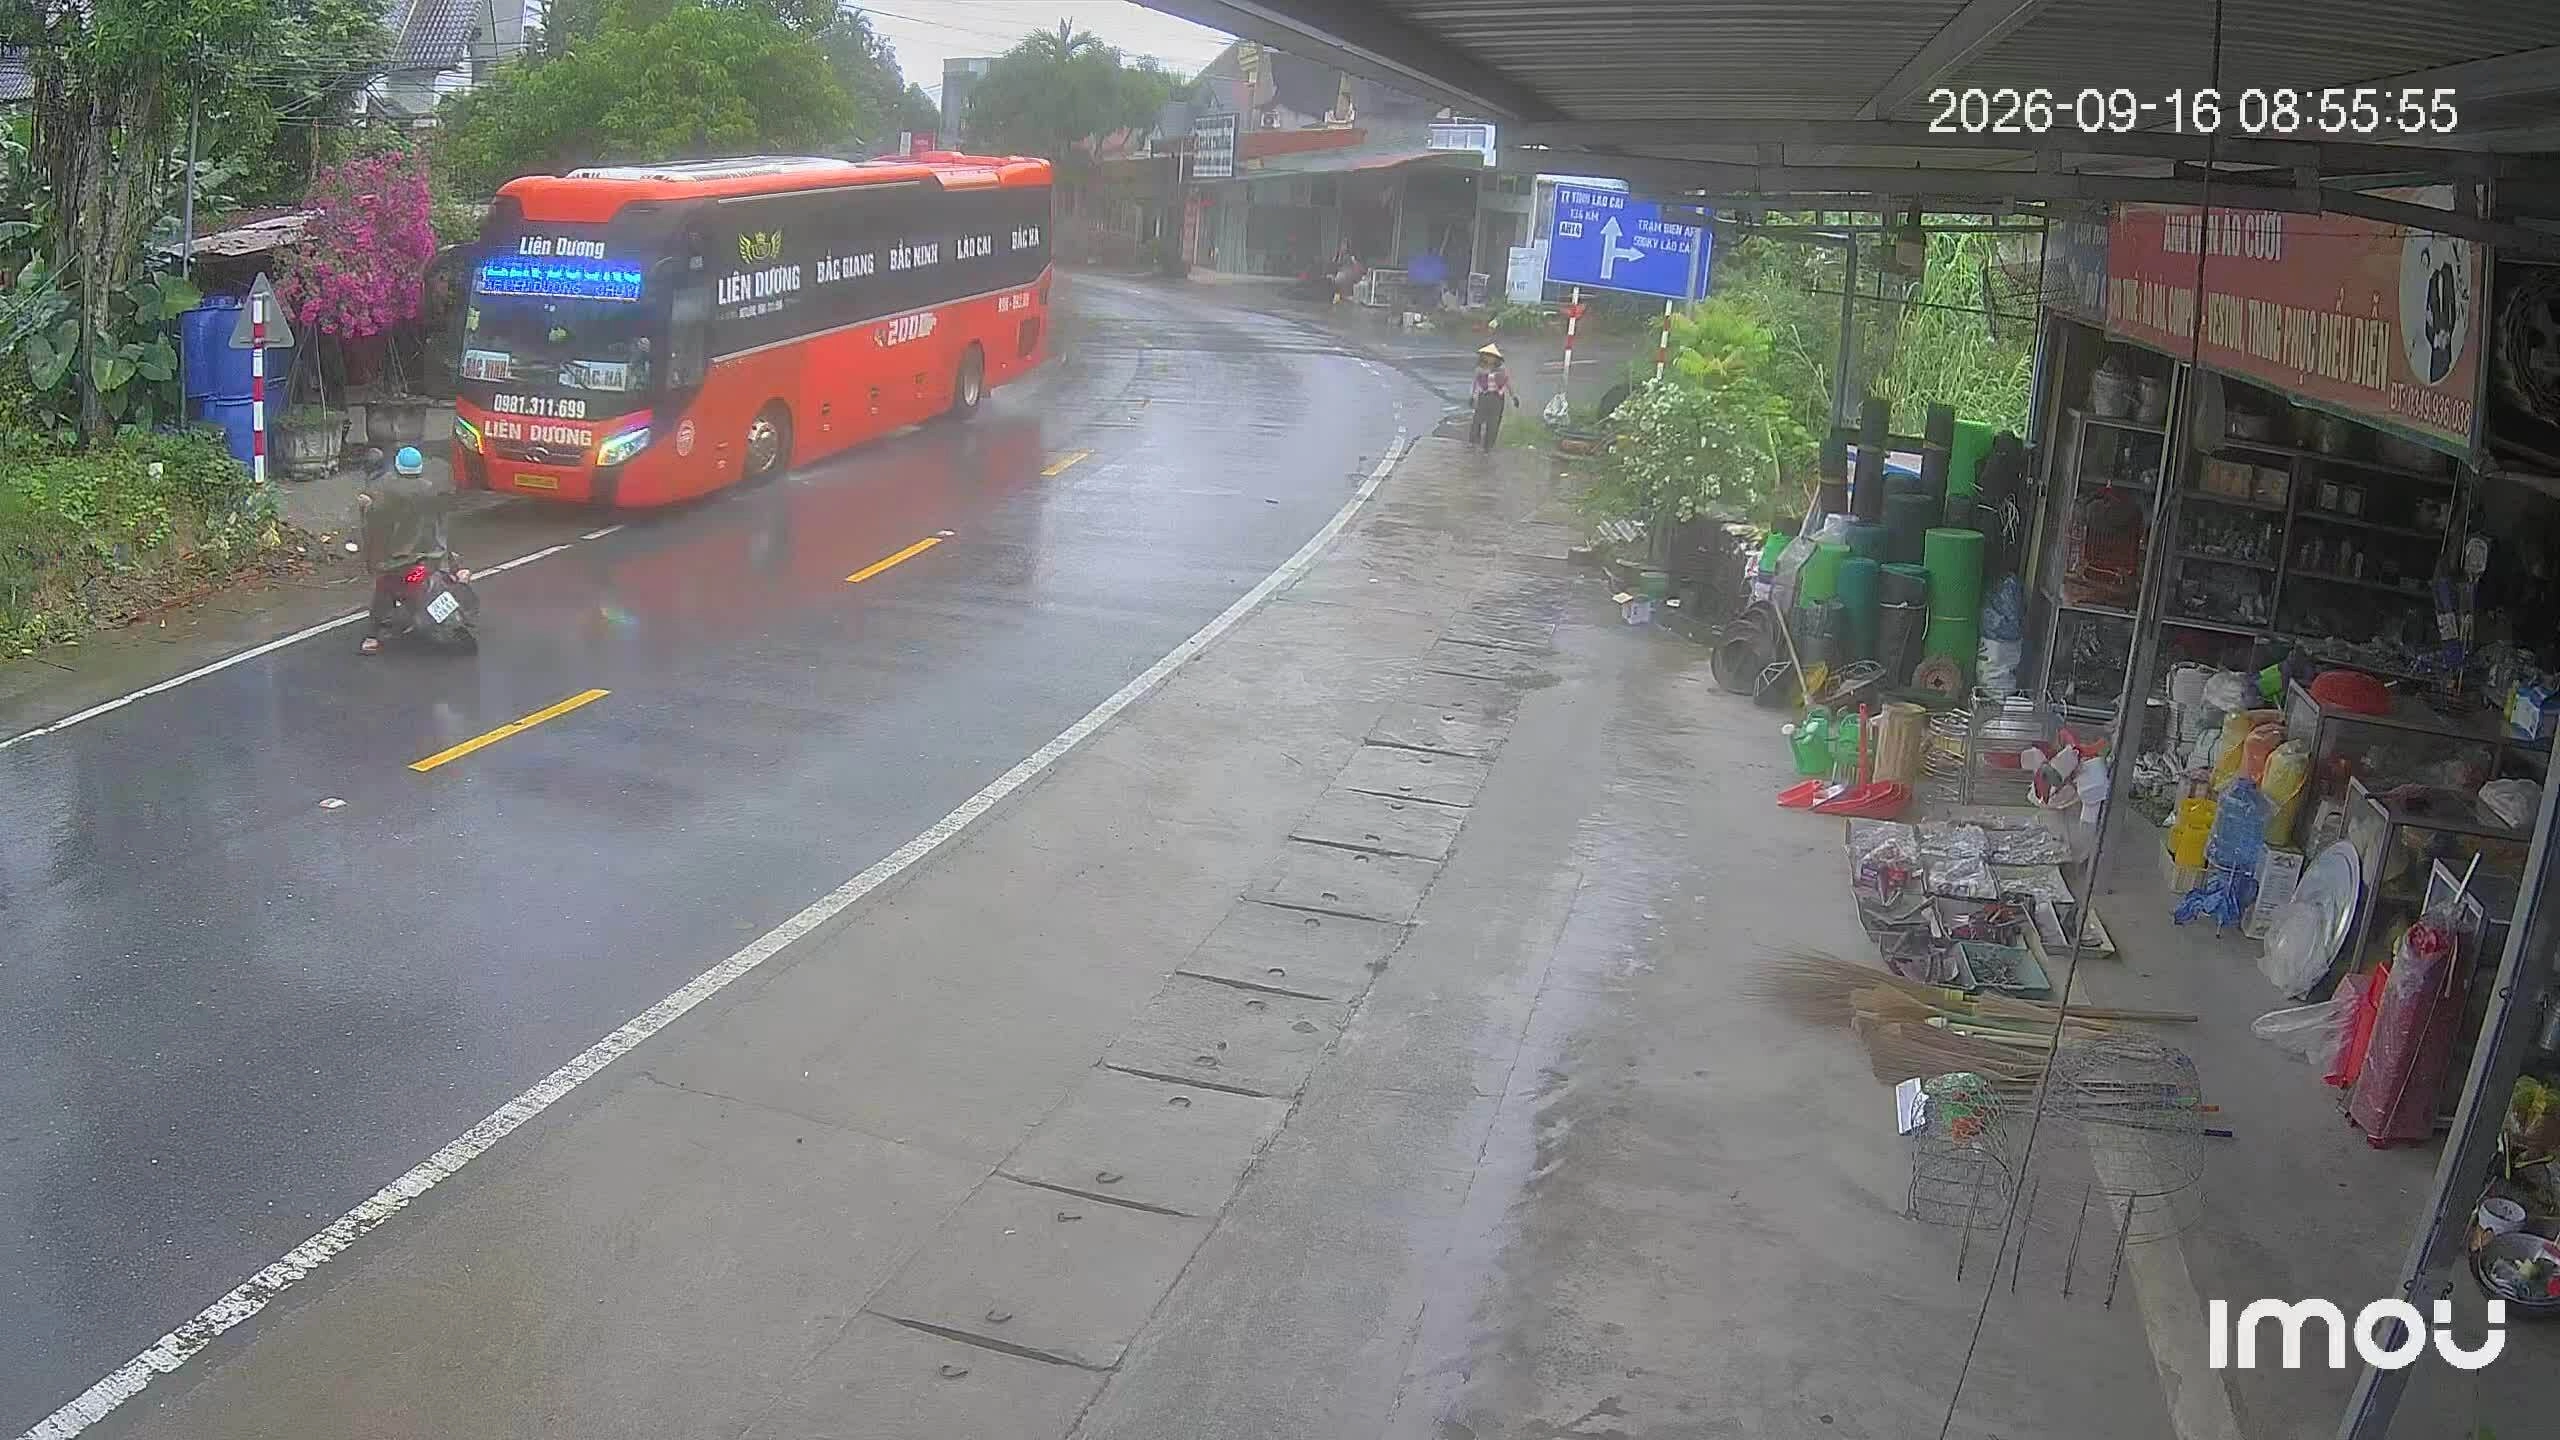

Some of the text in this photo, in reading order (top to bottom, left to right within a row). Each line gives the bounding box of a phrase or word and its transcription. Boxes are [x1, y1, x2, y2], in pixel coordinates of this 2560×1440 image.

[519, 235, 552, 256] Liên
[842, 252, 875, 280] GIANG
[718, 269, 751, 305] LIÊN
[493, 393, 586, 419] 0981.311.699
